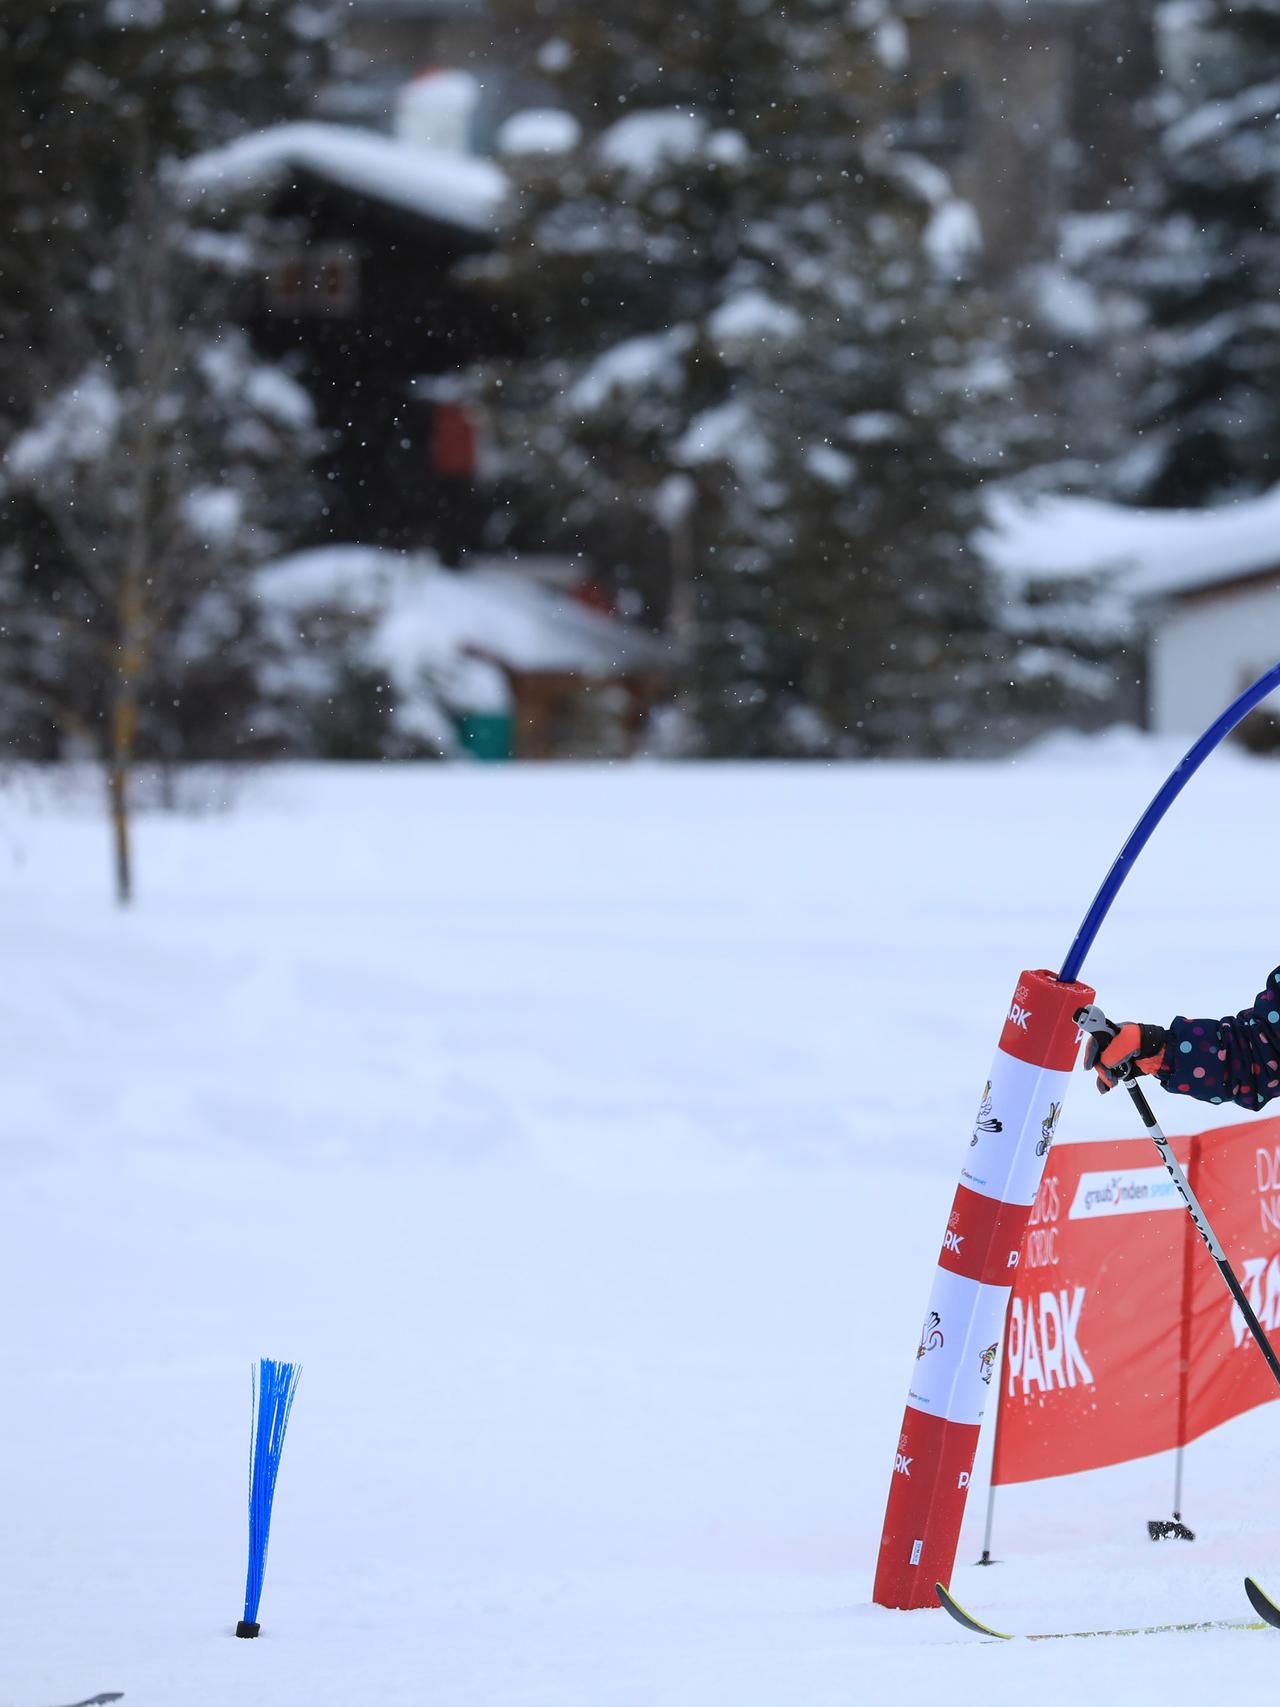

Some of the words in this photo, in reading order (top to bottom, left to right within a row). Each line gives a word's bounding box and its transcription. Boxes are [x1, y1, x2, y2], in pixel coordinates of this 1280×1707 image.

[1008, 1003, 1032, 1030] RK
[943, 1230, 965, 1254] RK
[1008, 1287, 1094, 1397] PARK
